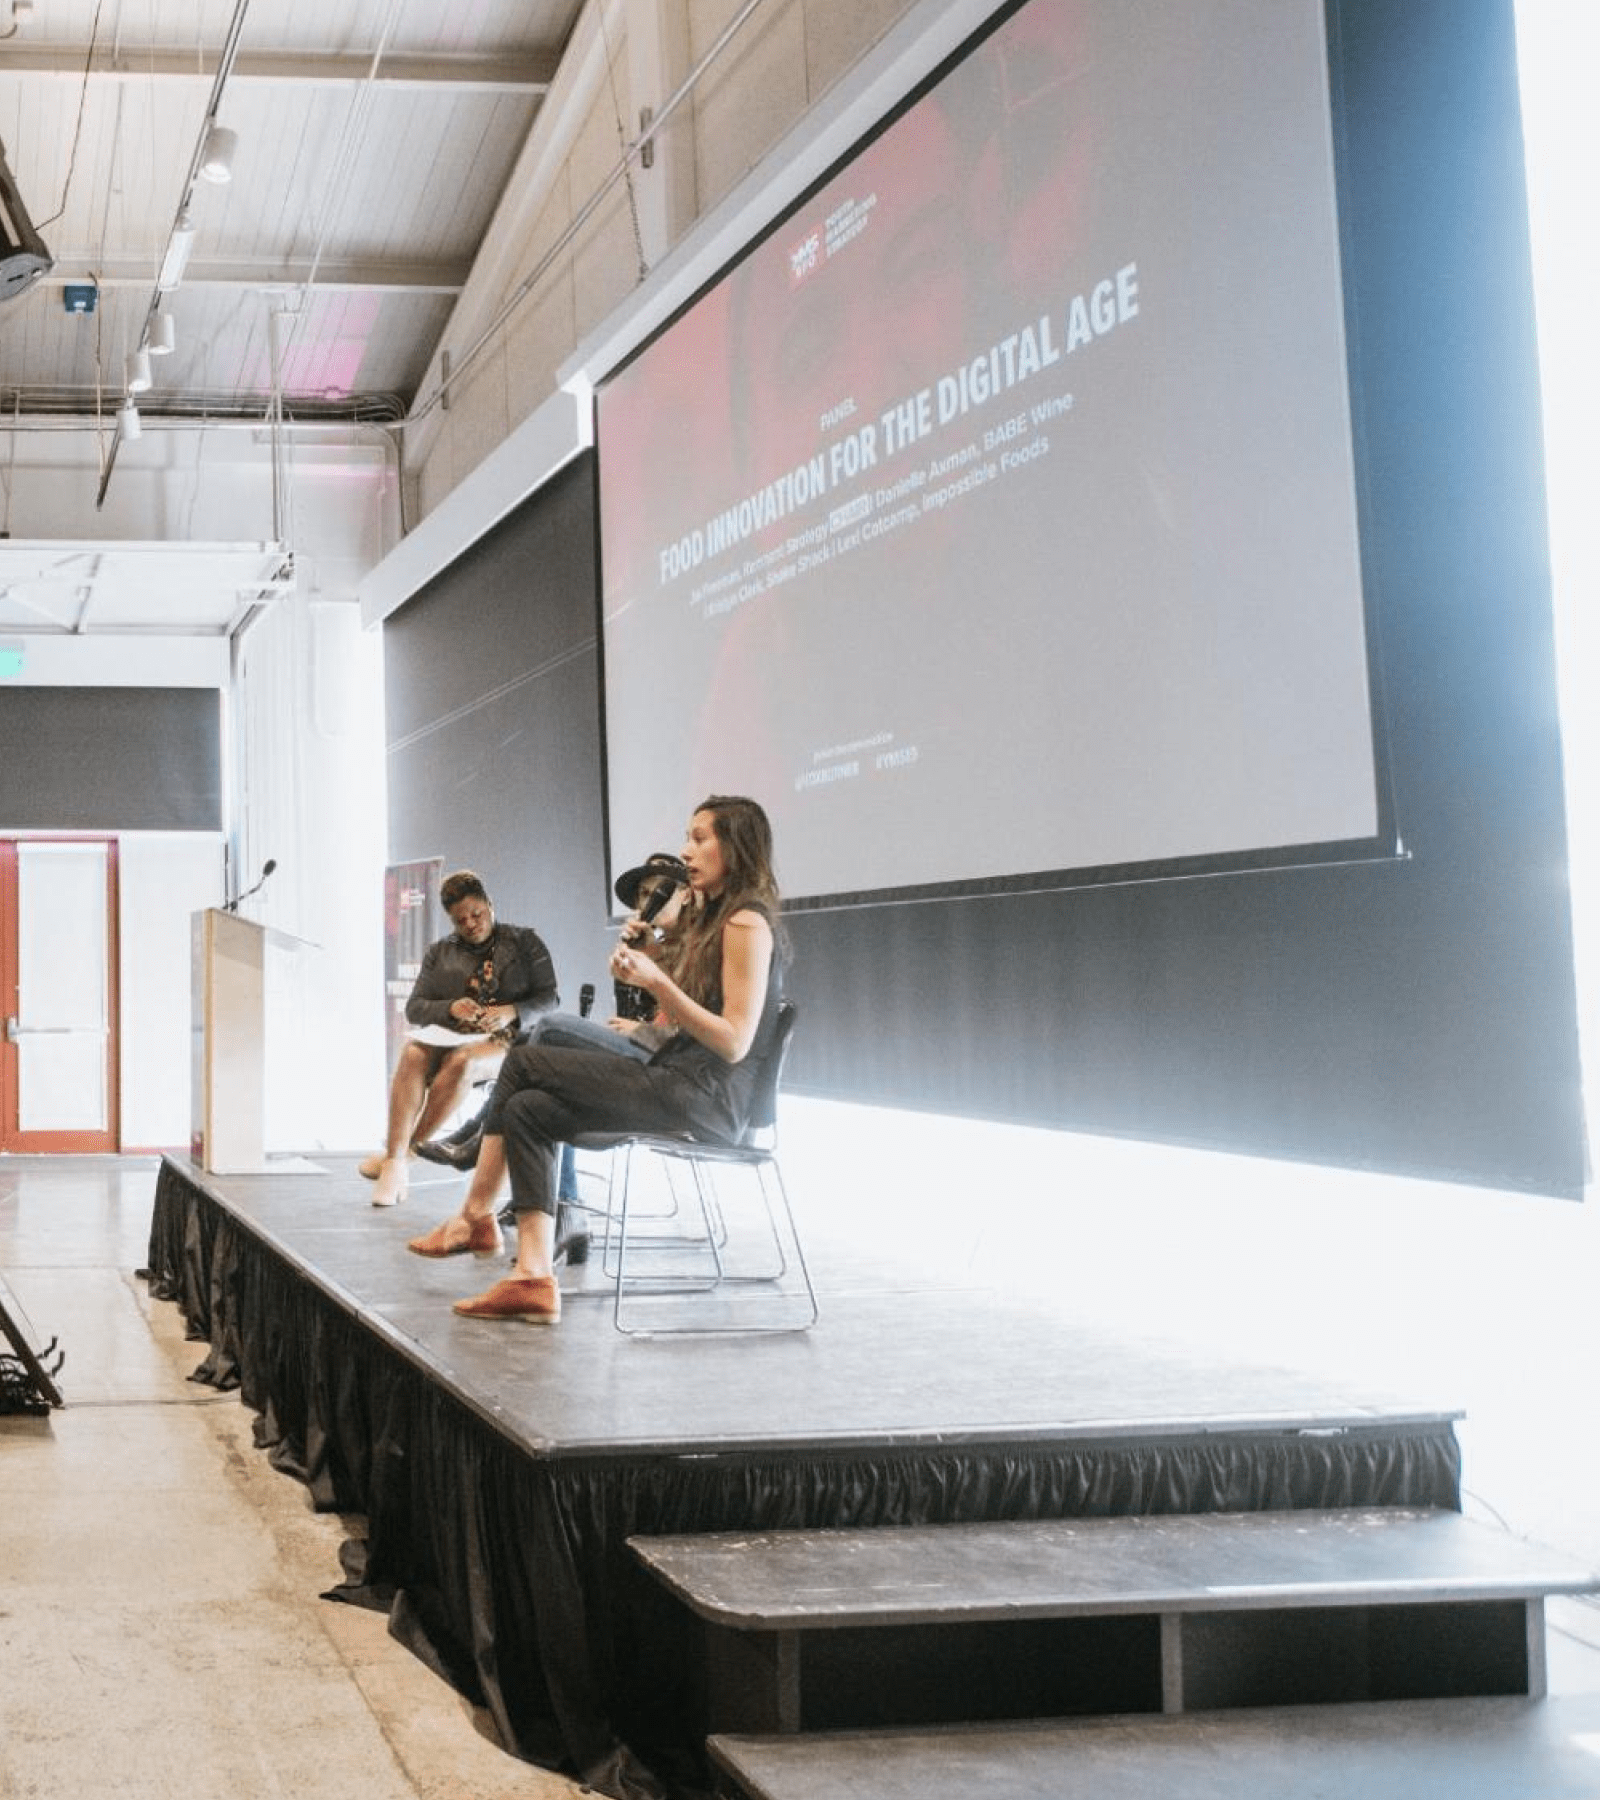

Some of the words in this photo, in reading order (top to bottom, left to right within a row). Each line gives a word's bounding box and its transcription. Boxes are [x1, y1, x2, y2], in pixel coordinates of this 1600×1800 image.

[659, 529, 704, 586] FOOD
[706, 453, 826, 559] INNOVATION
[830, 424, 878, 487] FOR
[882, 387, 933, 456] THE
[936, 314, 1061, 427] DIGITAL
[1066, 261, 1140, 355] AGE
[820, 398, 858, 432] PANEL
[983, 412, 1028, 451] BABE
[1029, 391, 1074, 426] Wine
[922, 459, 998, 513] Impossible
[1000, 434, 1050, 474] Foods
